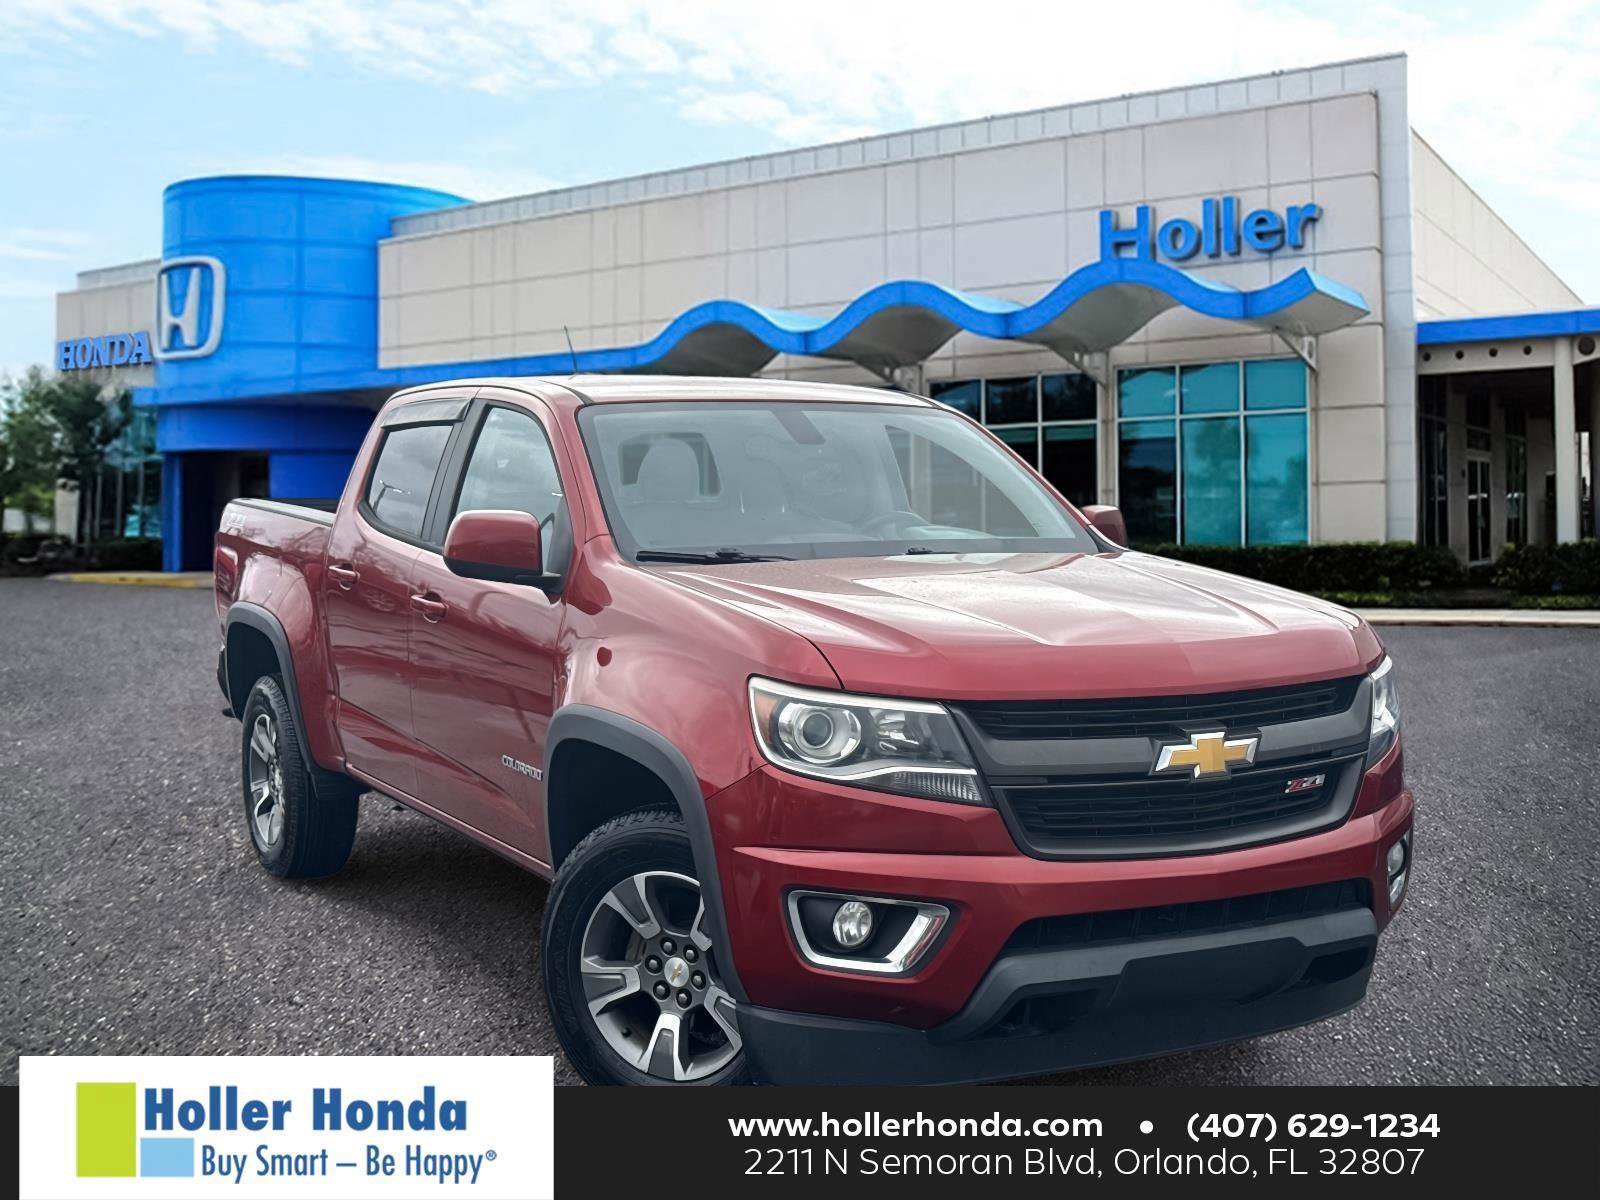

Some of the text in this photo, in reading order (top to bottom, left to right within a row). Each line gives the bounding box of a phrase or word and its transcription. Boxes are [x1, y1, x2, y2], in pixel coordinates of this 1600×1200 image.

[1099, 195, 1322, 262] Holler
[57, 331, 153, 371] HONDA
[502, 754, 543, 781] COLORADO
